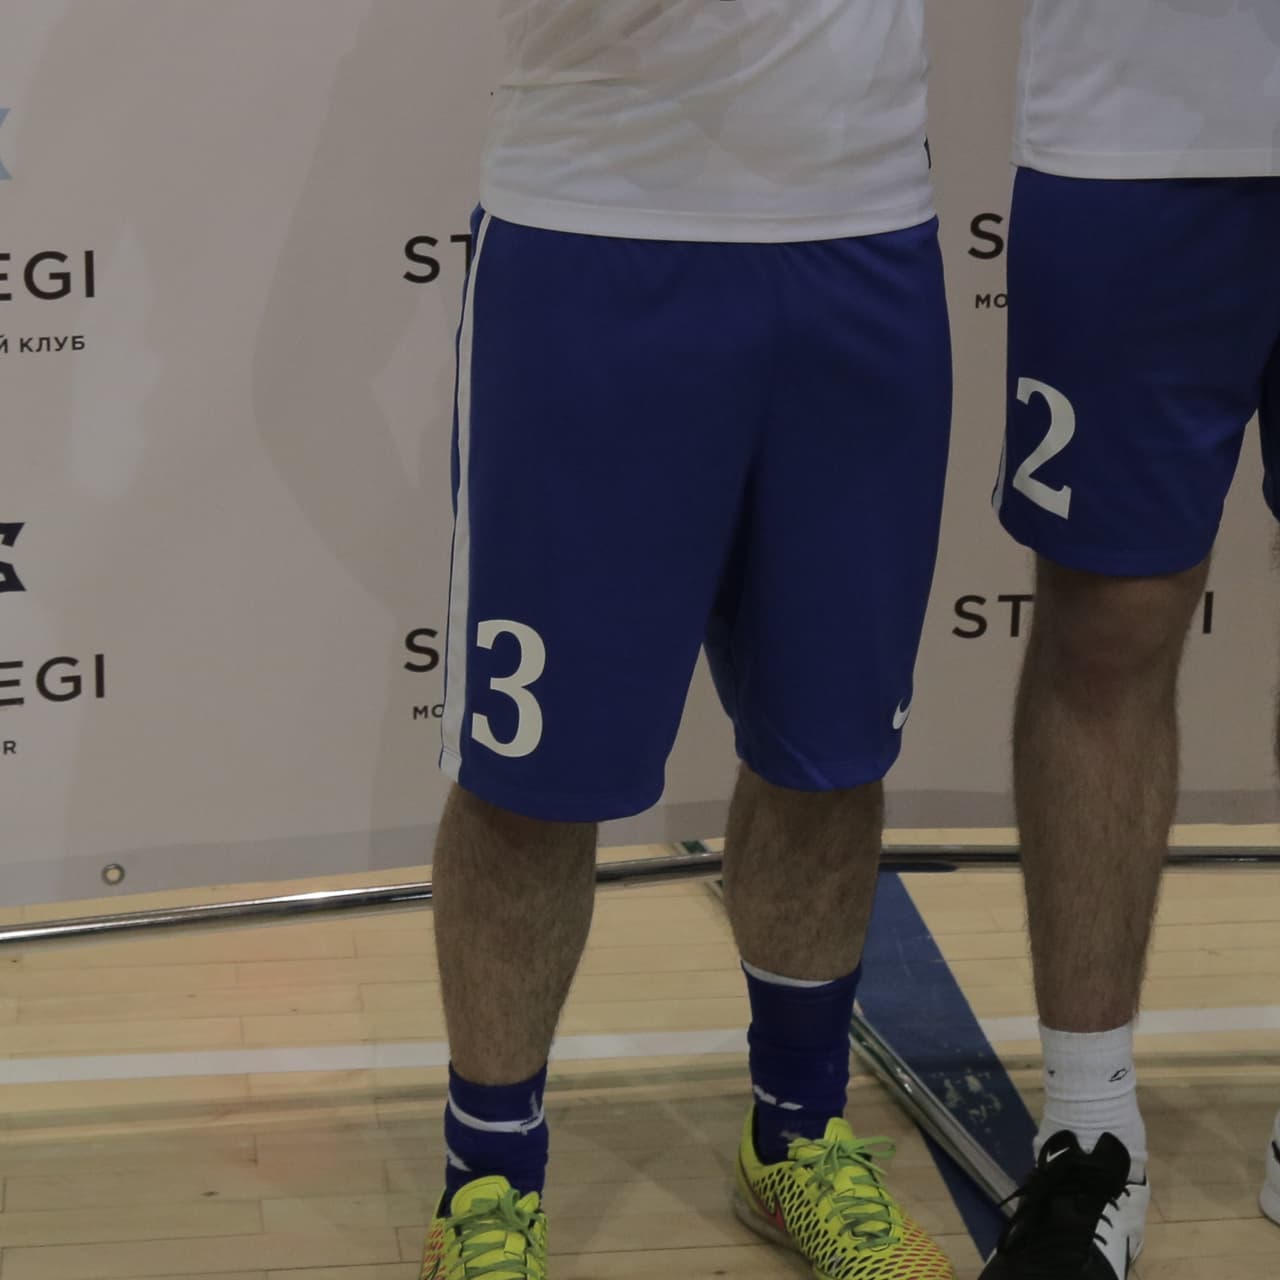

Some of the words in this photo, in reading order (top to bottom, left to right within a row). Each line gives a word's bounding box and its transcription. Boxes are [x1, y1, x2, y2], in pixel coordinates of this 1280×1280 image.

[19, 335, 86, 353] КЛУБ
[1012, 376, 1076, 519] 2
[470, 619, 546, 758] 3
